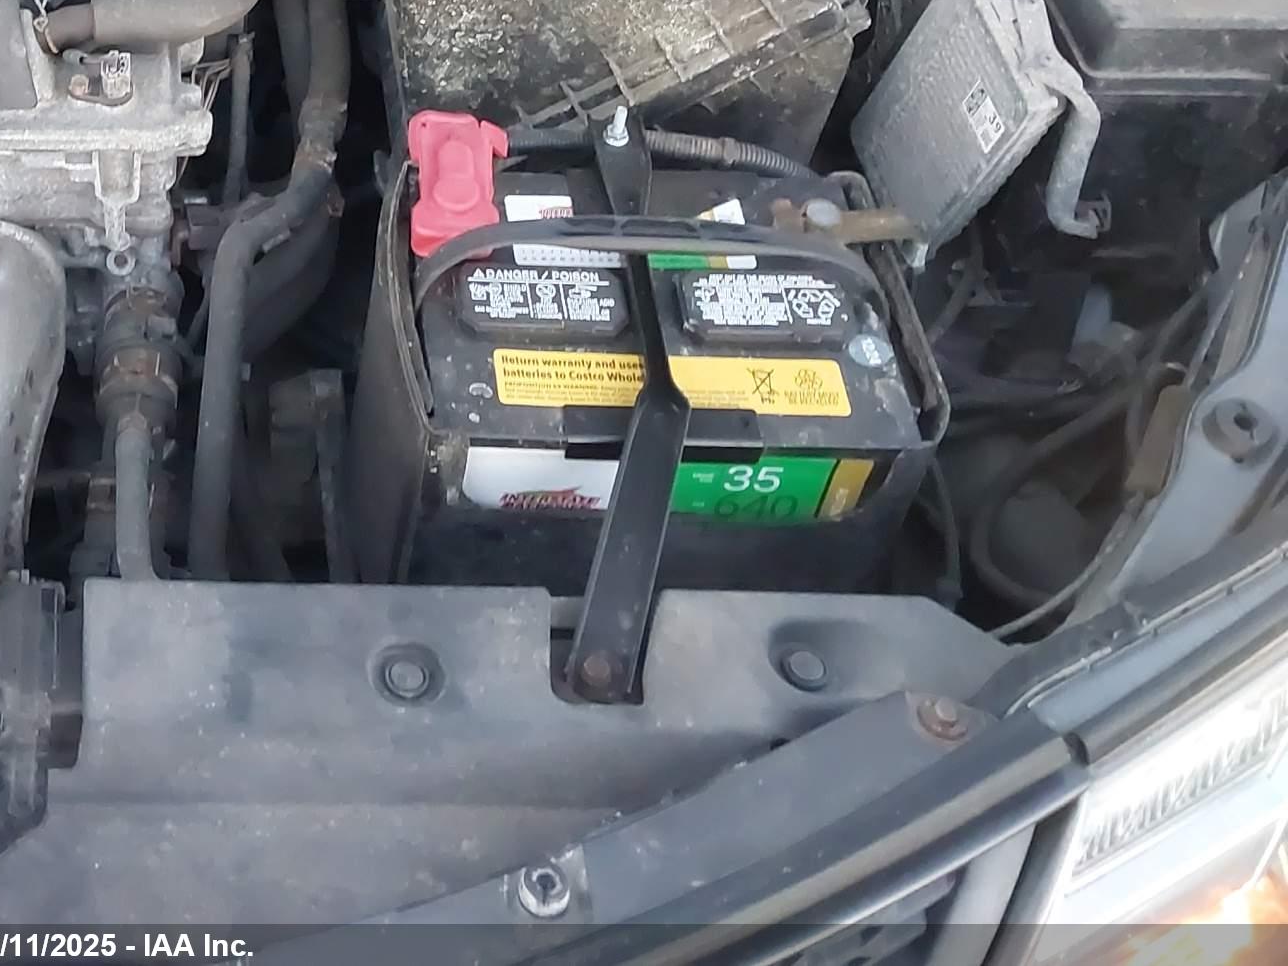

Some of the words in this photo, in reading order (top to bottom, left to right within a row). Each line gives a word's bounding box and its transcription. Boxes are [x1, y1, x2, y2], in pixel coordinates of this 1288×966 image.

[485, 269, 539, 282] DANGER
[551, 271, 600, 282] POISON
[501, 355, 540, 365] Return
[542, 358, 592, 370] warranty
[594, 359, 616, 369] and
[503, 369, 553, 380] batteries
[555, 370, 567, 380] to
[568, 370, 605, 381] Costco
[723, 465, 784, 493] 35
[714, 493, 799, 519] 640
